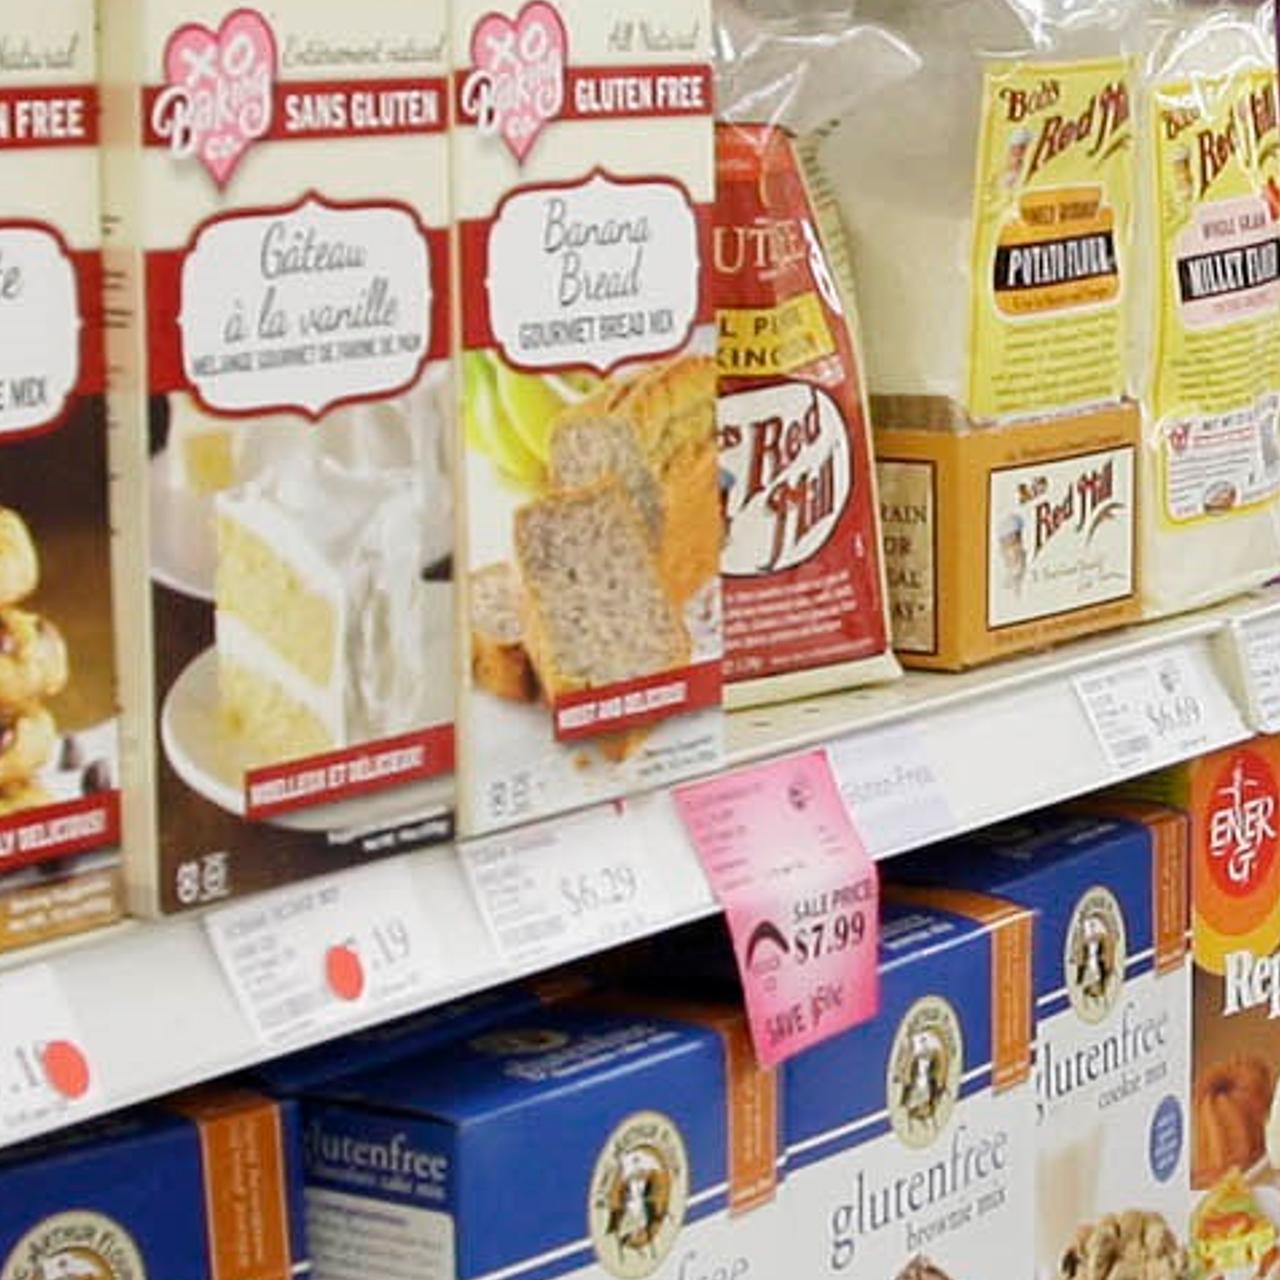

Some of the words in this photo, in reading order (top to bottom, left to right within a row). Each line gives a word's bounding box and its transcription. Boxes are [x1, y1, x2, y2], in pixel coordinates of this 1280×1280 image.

[16, 98, 86, 139] FREE
[151, 62, 272, 159] Baking
[283, 93, 347, 131] SANS
[350, 87, 439, 129] GLUTEN
[461, 53, 566, 137] Baking
[574, 77, 652, 113] GLUTEN
[656, 72, 706, 108] FREE
[998, 81, 1062, 123] Bob's
[1024, 103, 1096, 181] Red
[259, 219, 368, 279] Gâteau
[542, 197, 652, 252] Banana
[556, 249, 643, 309] Bread
[1188, 250, 1243, 295] MILLET
[223, 301, 246, 345] à
[256, 288, 290, 340] la
[296, 276, 399, 335] vanille
[517, 317, 596, 352] GOURMET
[598, 312, 646, 340] BREAD
[9, 376, 49, 407] MIX
[744, 396, 823, 509] Red
[765, 462, 839, 574] Mill
[1031, 487, 1077, 555] Red
[1078, 460, 1116, 525] Mill
[560, 864, 639, 917] $6.29
[793, 911, 868, 965] $7.99
[764, 1005, 808, 1044] SAVE
[829, 1125, 1010, 1271] glutenfree
[904, 1208, 974, 1258] brownie
[976, 1184, 1009, 1223] mix
